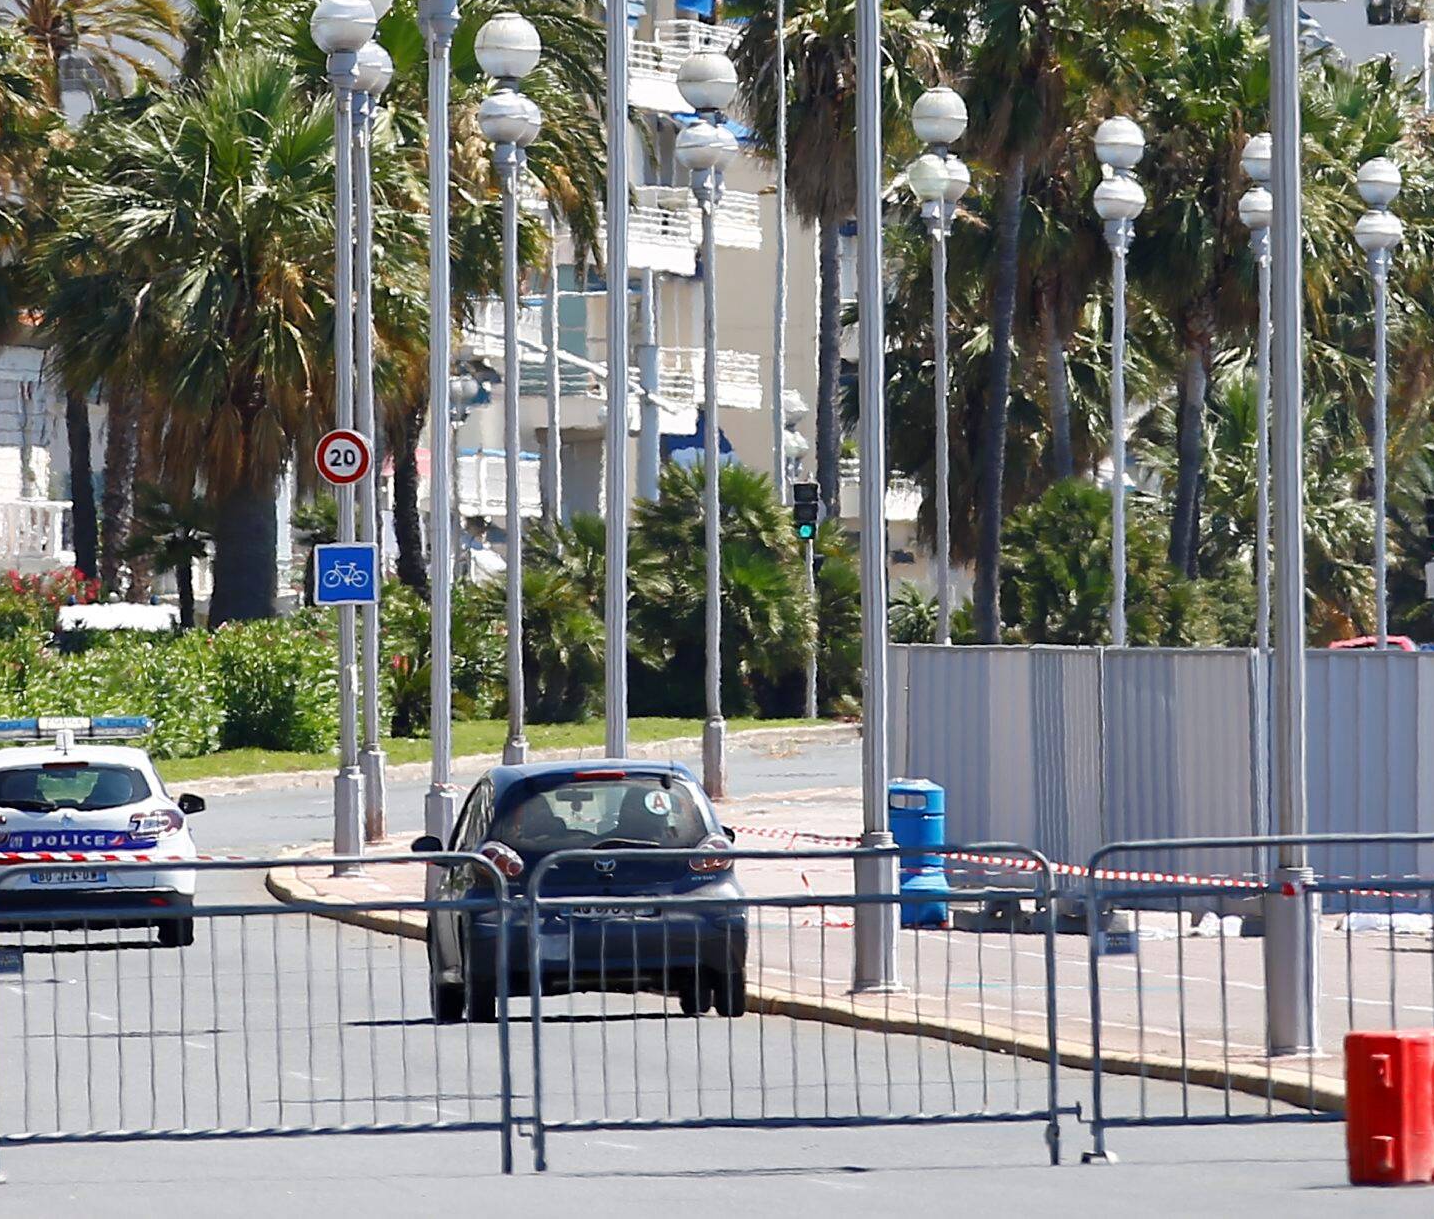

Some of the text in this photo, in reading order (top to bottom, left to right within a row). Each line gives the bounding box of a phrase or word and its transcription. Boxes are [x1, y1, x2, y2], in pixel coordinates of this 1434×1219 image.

[329, 448, 356, 467] 20
[653, 793, 666, 809] A
[31, 835, 105, 847] POLICE
